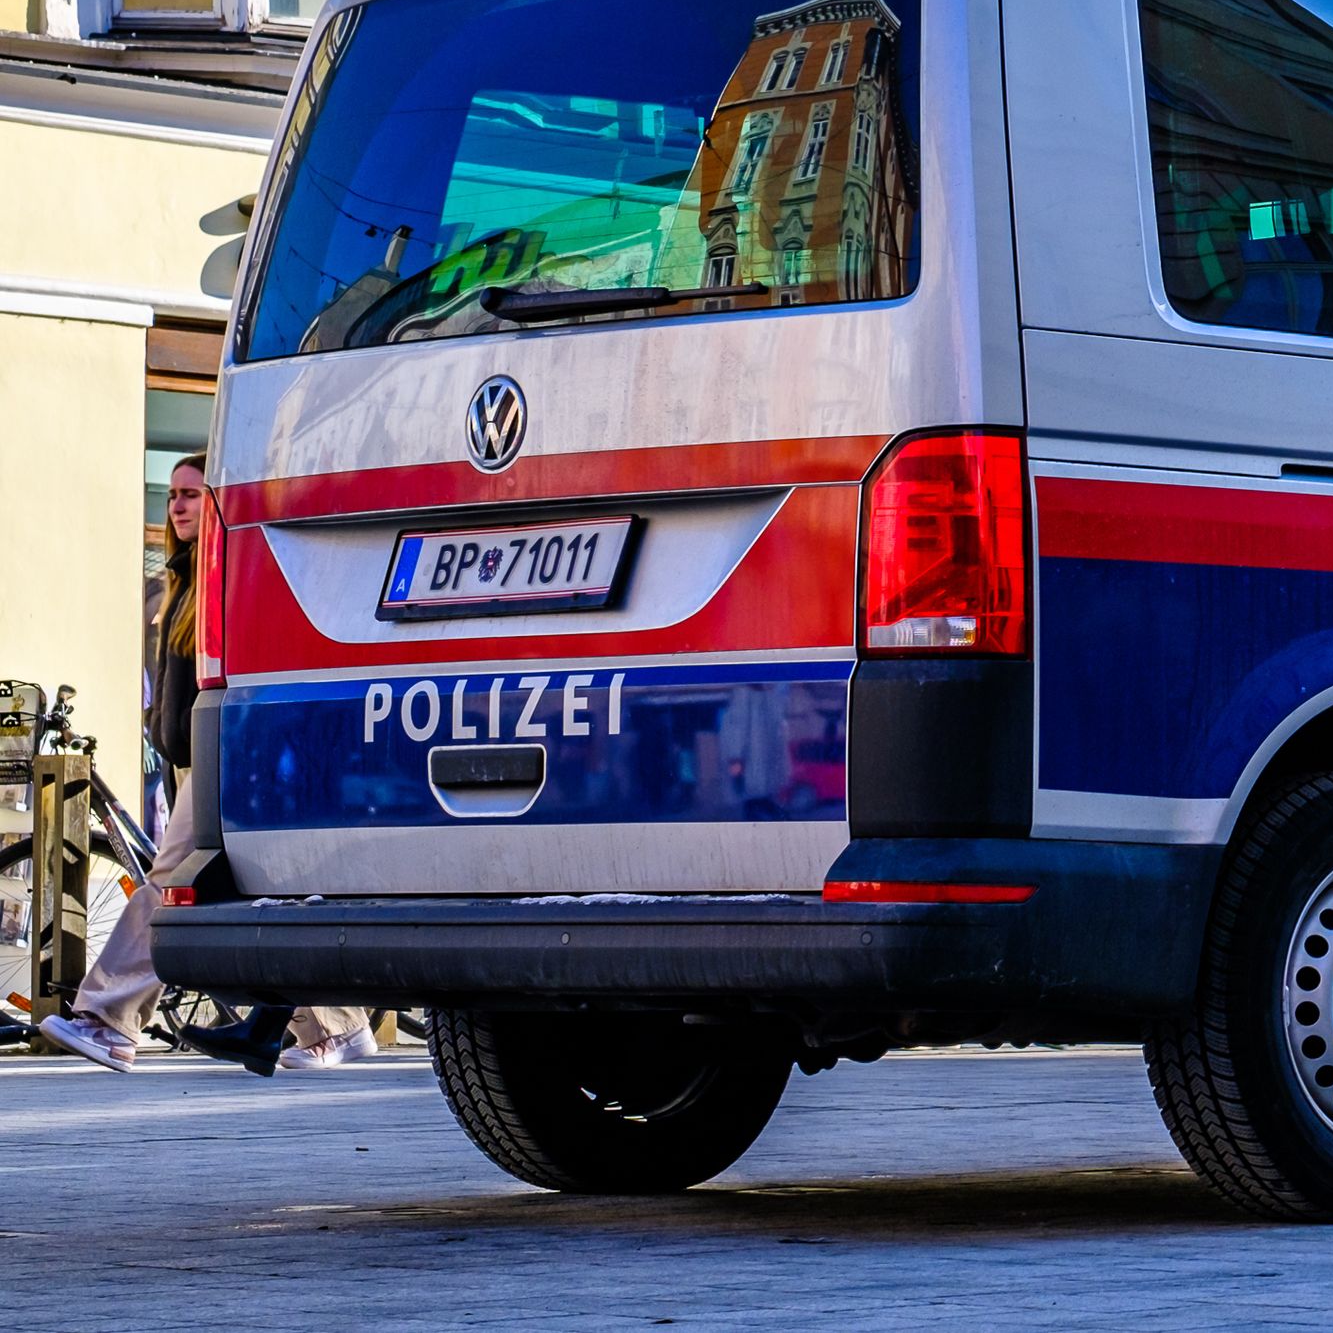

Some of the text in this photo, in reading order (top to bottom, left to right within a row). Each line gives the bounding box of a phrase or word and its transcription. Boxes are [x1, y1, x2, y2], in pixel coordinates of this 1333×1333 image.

[395, 579, 405, 592] A
[430, 532, 600, 591] BP 71011
[363, 673, 624, 743] POLIZEI
